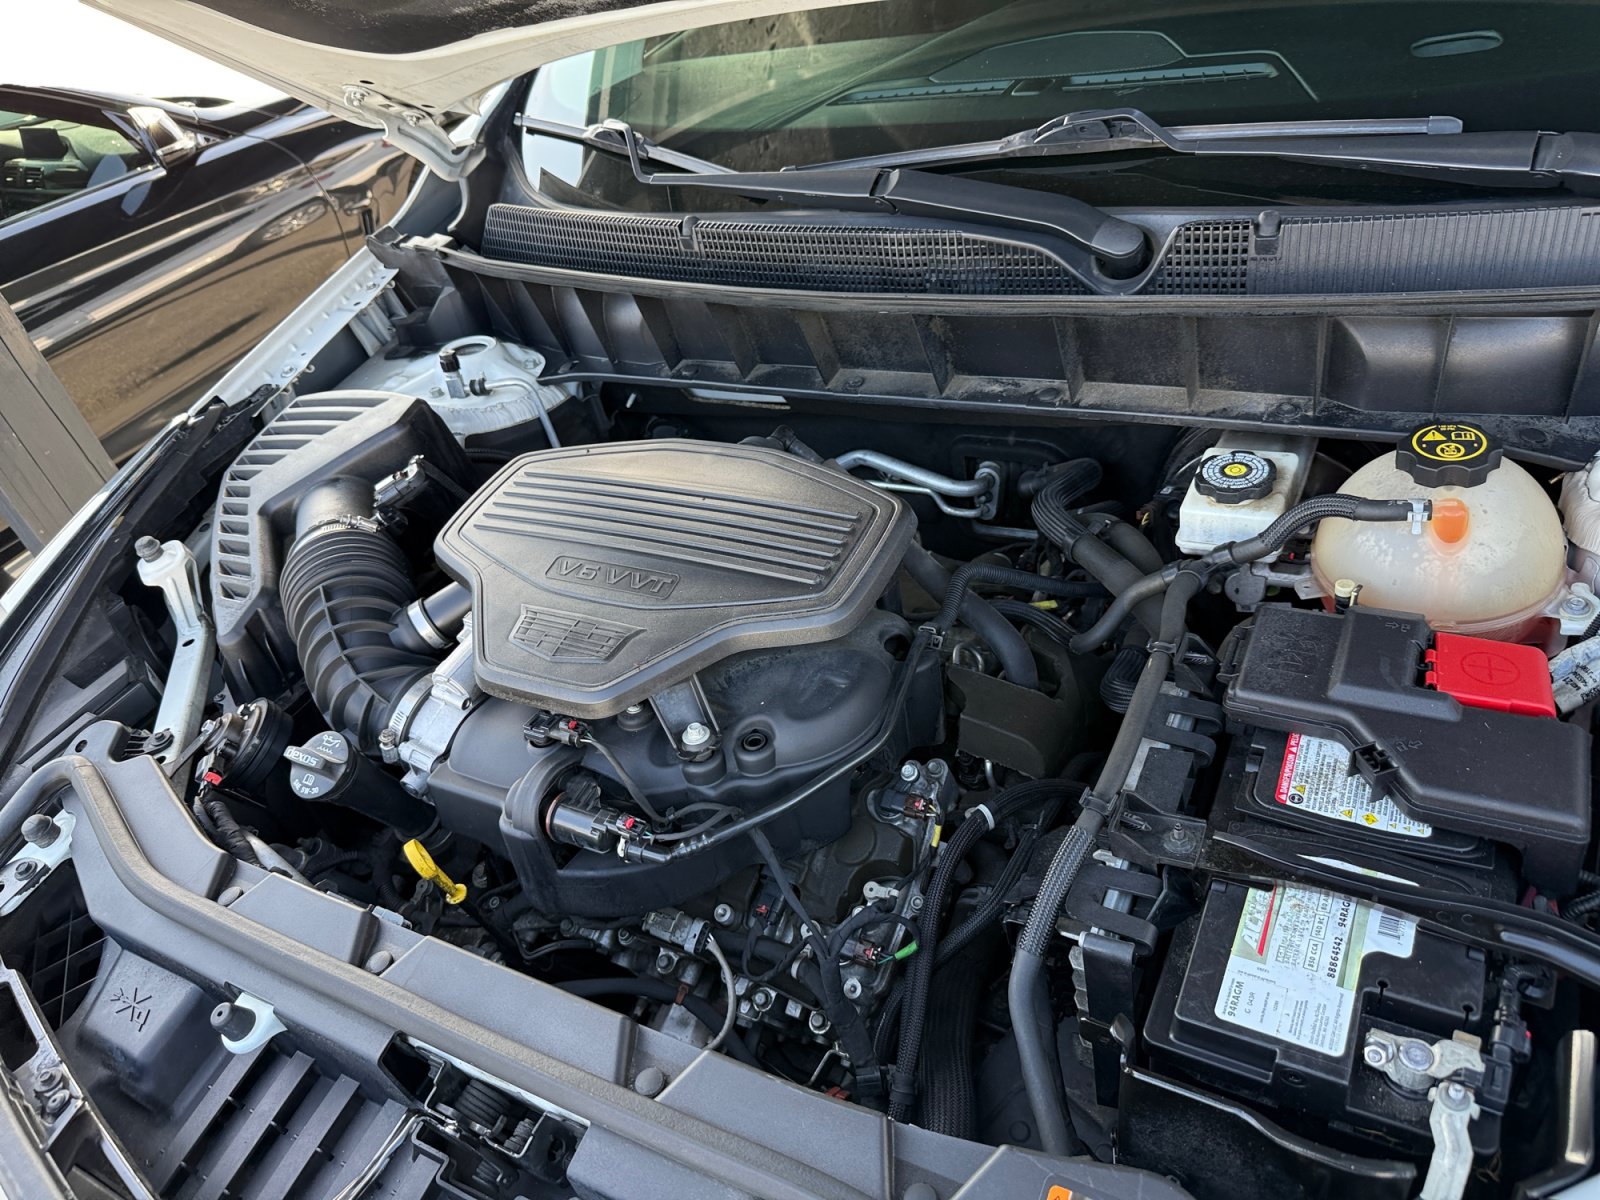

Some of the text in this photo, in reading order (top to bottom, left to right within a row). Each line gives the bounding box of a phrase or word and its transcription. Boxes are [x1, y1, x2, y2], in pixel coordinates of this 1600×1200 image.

[558, 558, 673, 593] V6 VVT
[286, 746, 319, 766] dexos
[1310, 942, 1318, 955] CCA
[1325, 936, 1344, 978] 88864542
[1228, 981, 1244, 1016] 94RAGM
